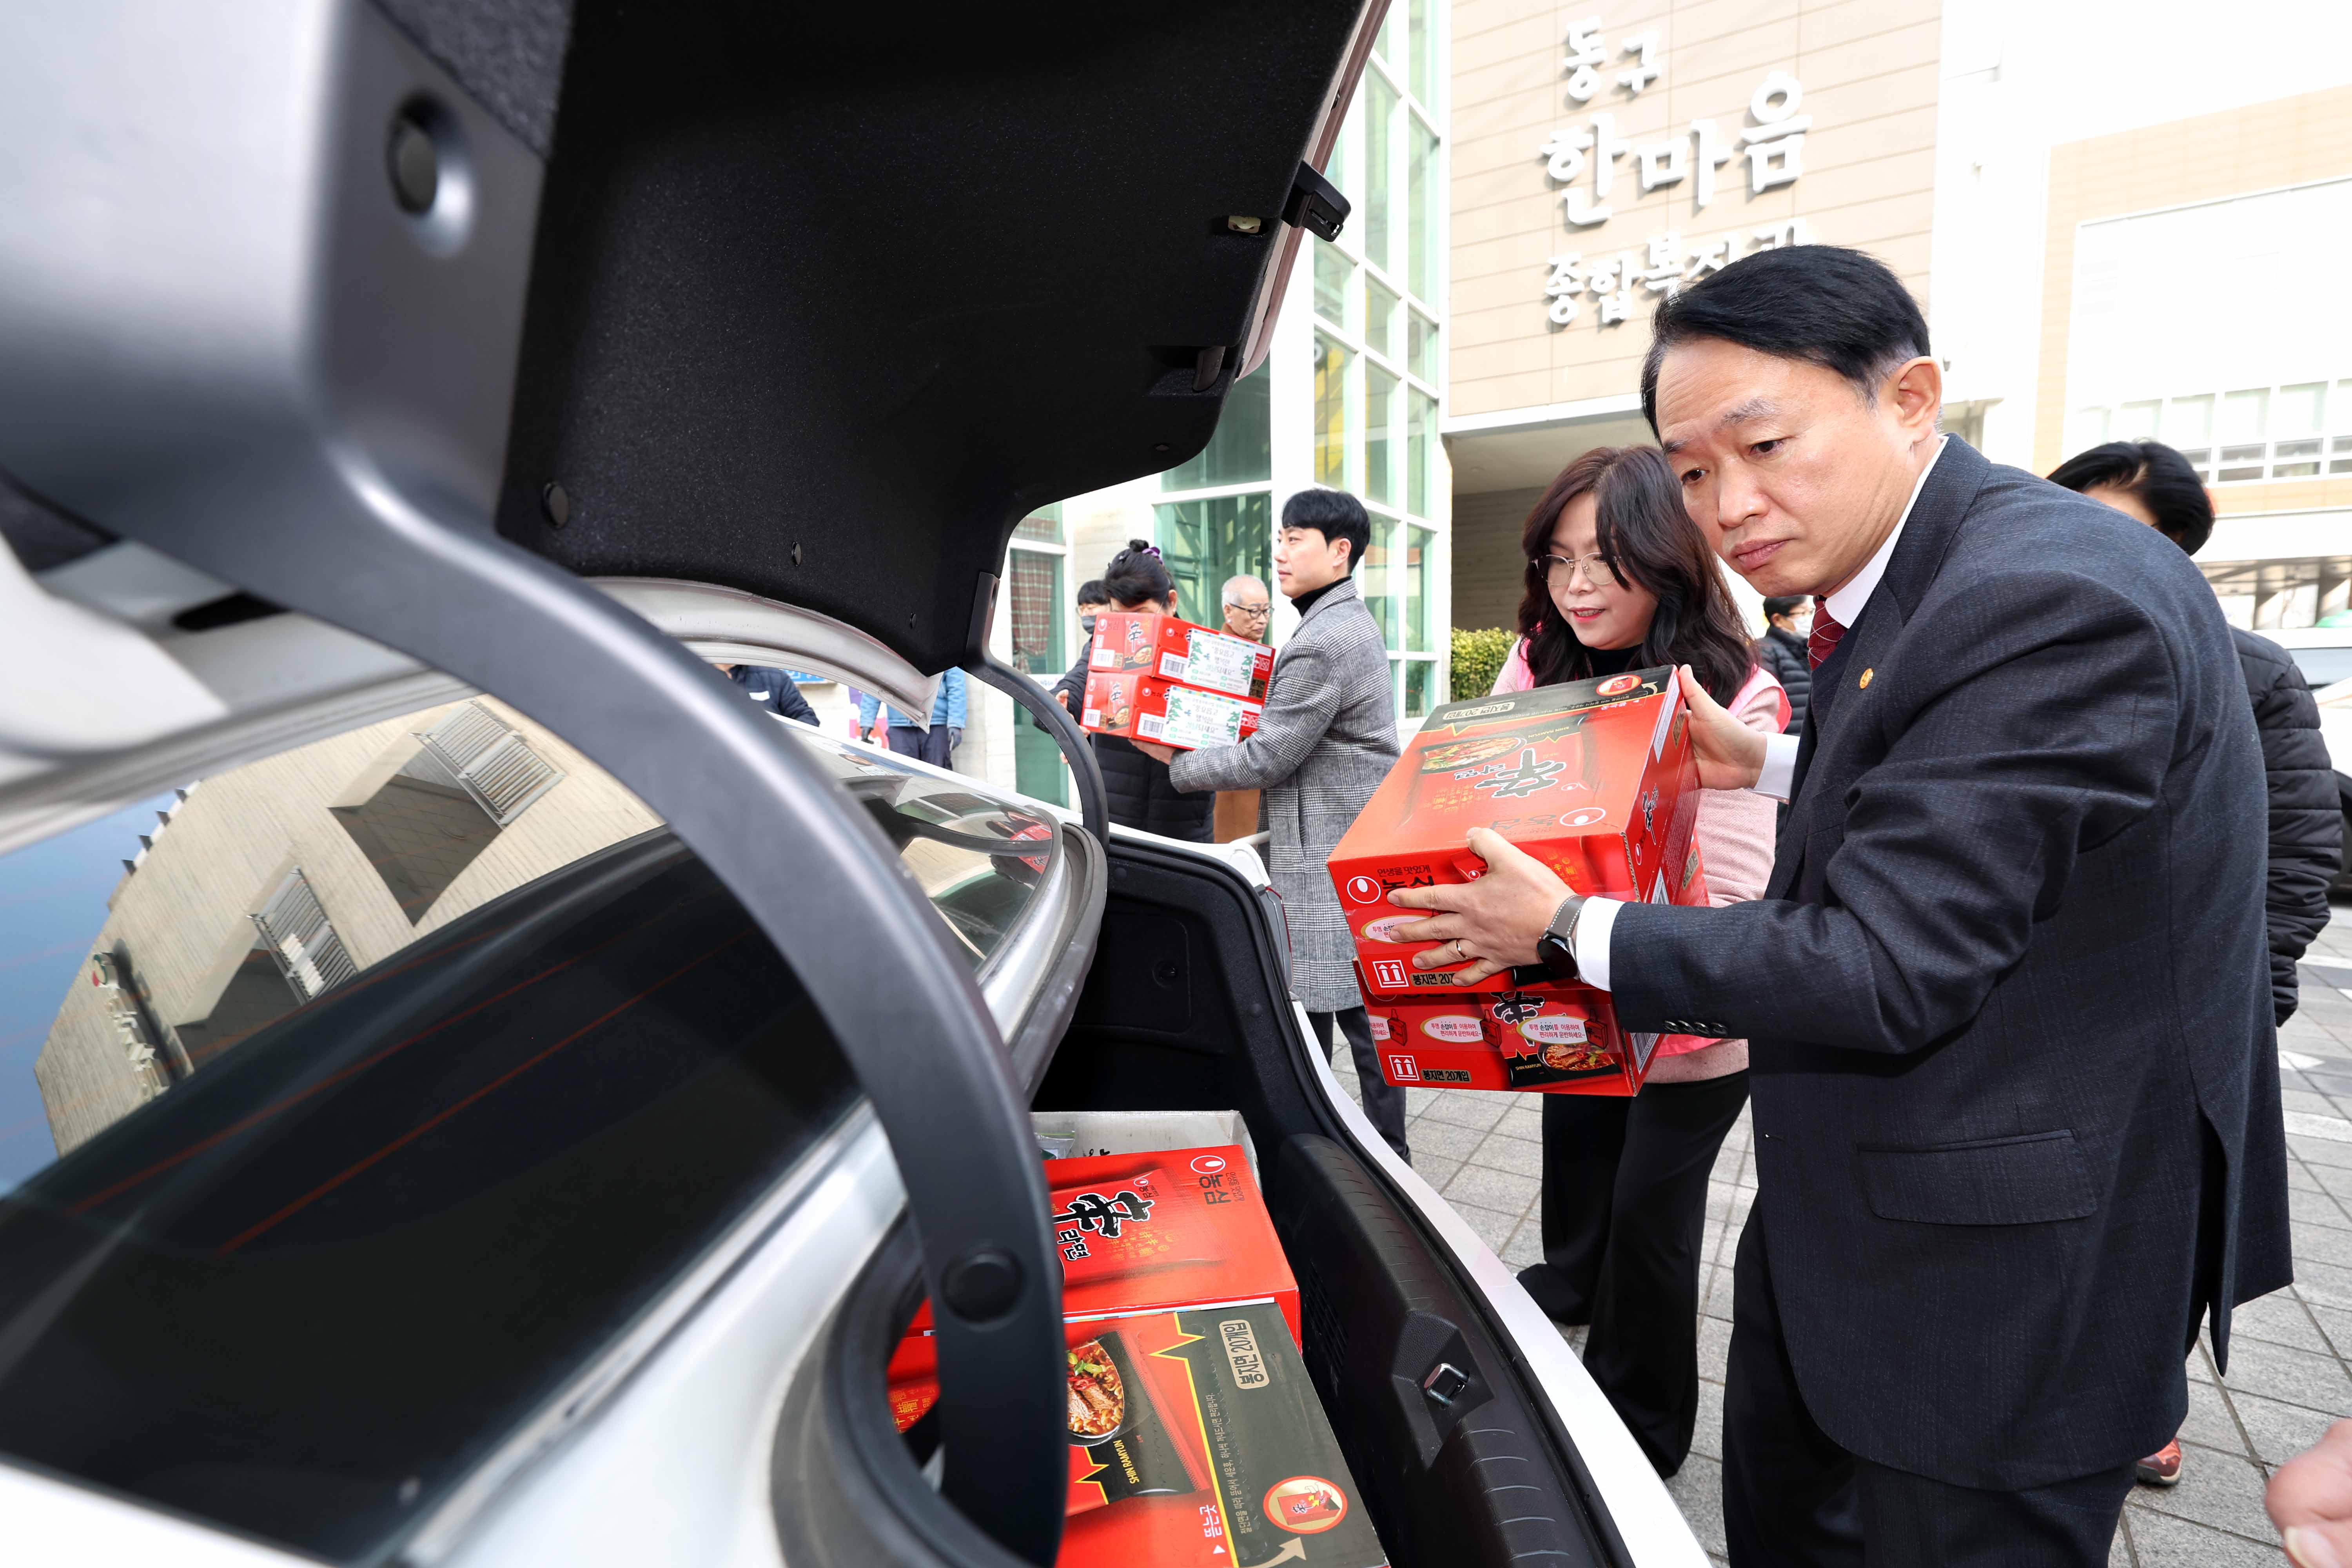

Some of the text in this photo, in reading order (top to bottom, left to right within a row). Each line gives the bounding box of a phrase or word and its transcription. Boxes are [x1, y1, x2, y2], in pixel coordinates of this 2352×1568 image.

[1563, 15, 1662, 102] 동구
[1540, 71, 1813, 225] 한마음
[1445, 709, 1478, 719] 20개입
[1480, 703, 1510, 715] 봉지면
[1474, 748, 1566, 798] 辛
[1377, 864, 1431, 877] 인생을 맛있게
[1413, 973, 1438, 985] 봉지면
[1423, 1069, 1470, 1082] 봉지면 20개입
[1199, 1174, 1231, 1205] 농심
[1057, 1228, 1091, 1261] 라면
[1222, 1322, 1265, 1385] 봉지면 20개입
[1113, 1439, 1140, 1484] SHIN RAMYUN
[1217, 1443, 1231, 1459] 하나씩
[1227, 1479, 1243, 1496] 뜯어서
[1232, 1497, 1245, 1509] 따라
[1199, 1504, 1223, 1538] 뜯는곳
[1235, 1510, 1252, 1534] 절단면을
